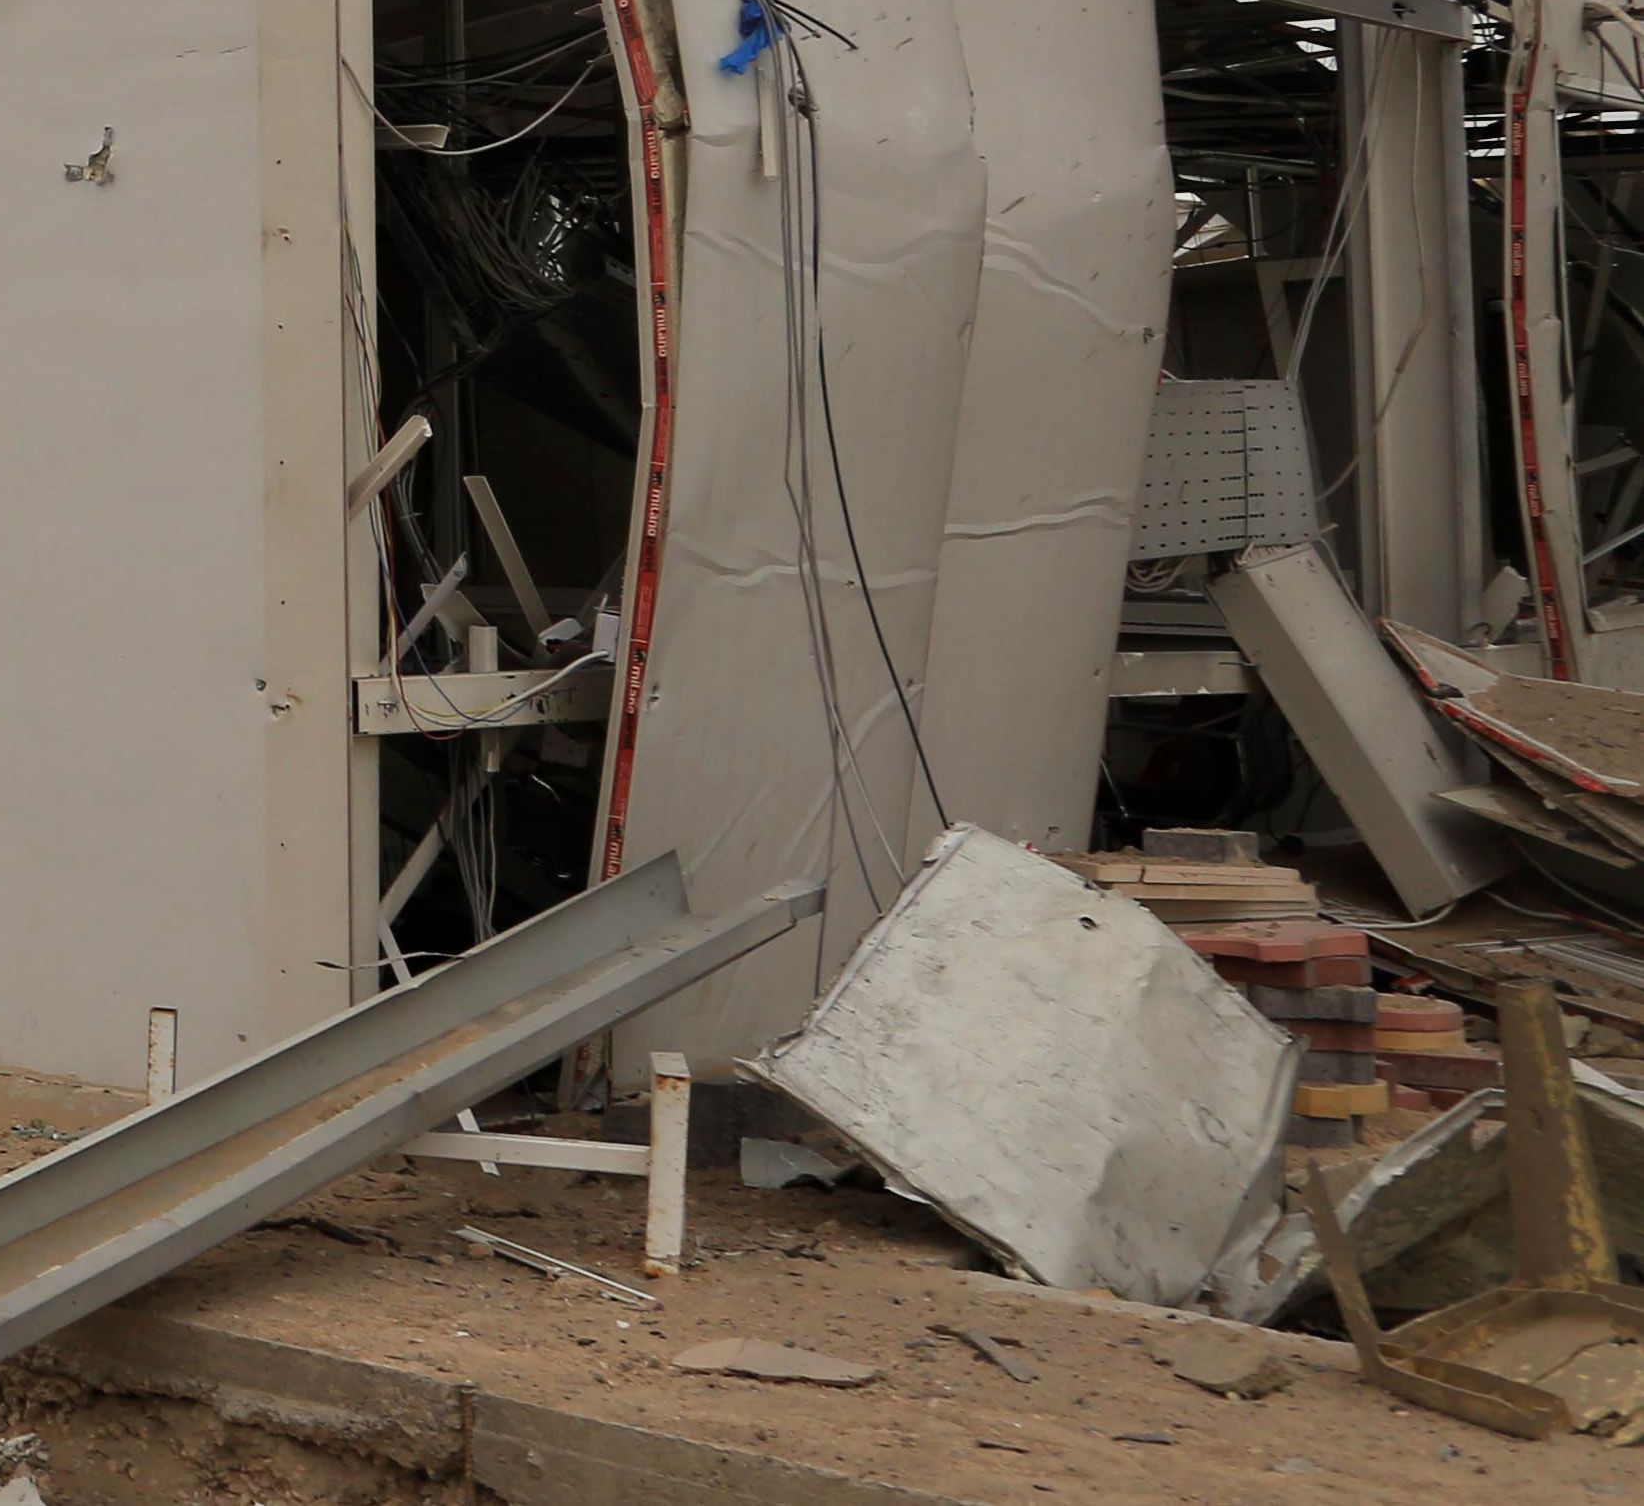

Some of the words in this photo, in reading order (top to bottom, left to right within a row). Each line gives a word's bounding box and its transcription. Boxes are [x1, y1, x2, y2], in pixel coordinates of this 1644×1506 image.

[645, 130, 660, 180] milano
[655, 308, 668, 358] milano
[647, 488, 661, 537] milano
[627, 665, 642, 714] milano
